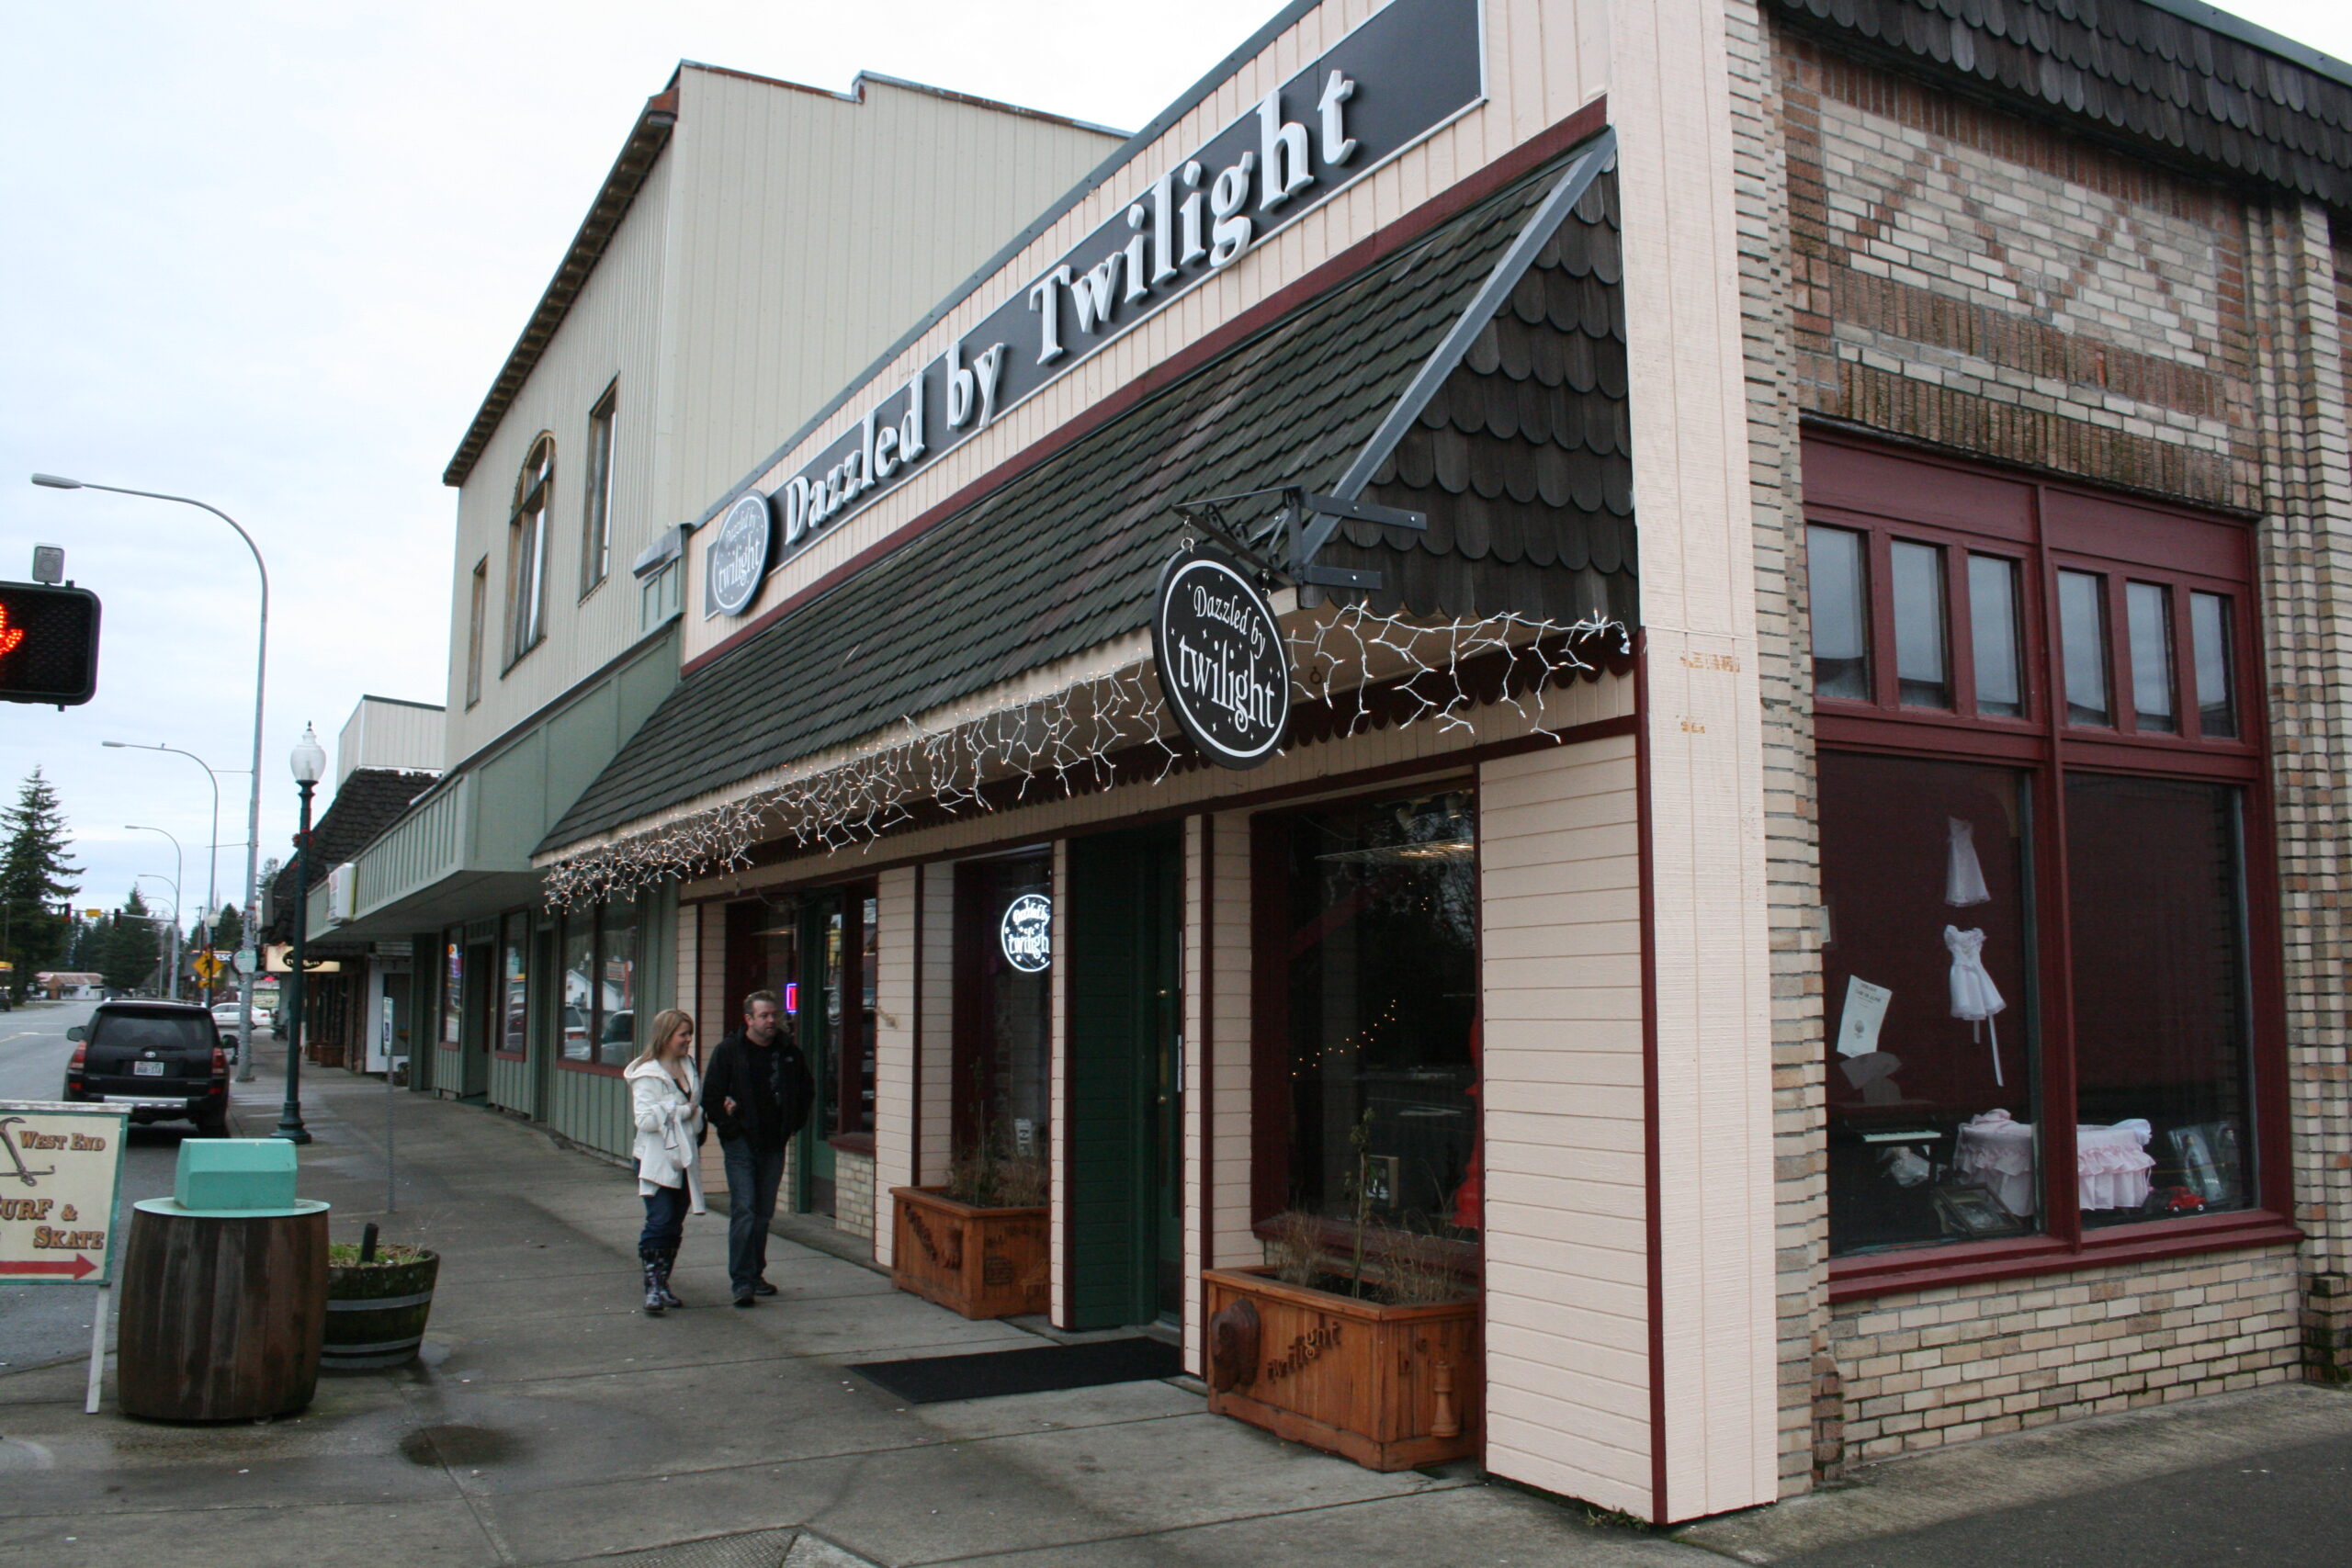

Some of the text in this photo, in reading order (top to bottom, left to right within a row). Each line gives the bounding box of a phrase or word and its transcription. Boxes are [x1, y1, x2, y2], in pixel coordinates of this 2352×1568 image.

[786, 70, 1356, 546] Dazzled by Twilight
[718, 533, 761, 593] twilight
[1193, 585, 1266, 659] Dazzled by
[1178, 635, 1275, 732] twilight
[19, 1130, 107, 1151] WEST END
[0, 1196, 78, 1221] URF &
[33, 1225, 105, 1249] SKATE
